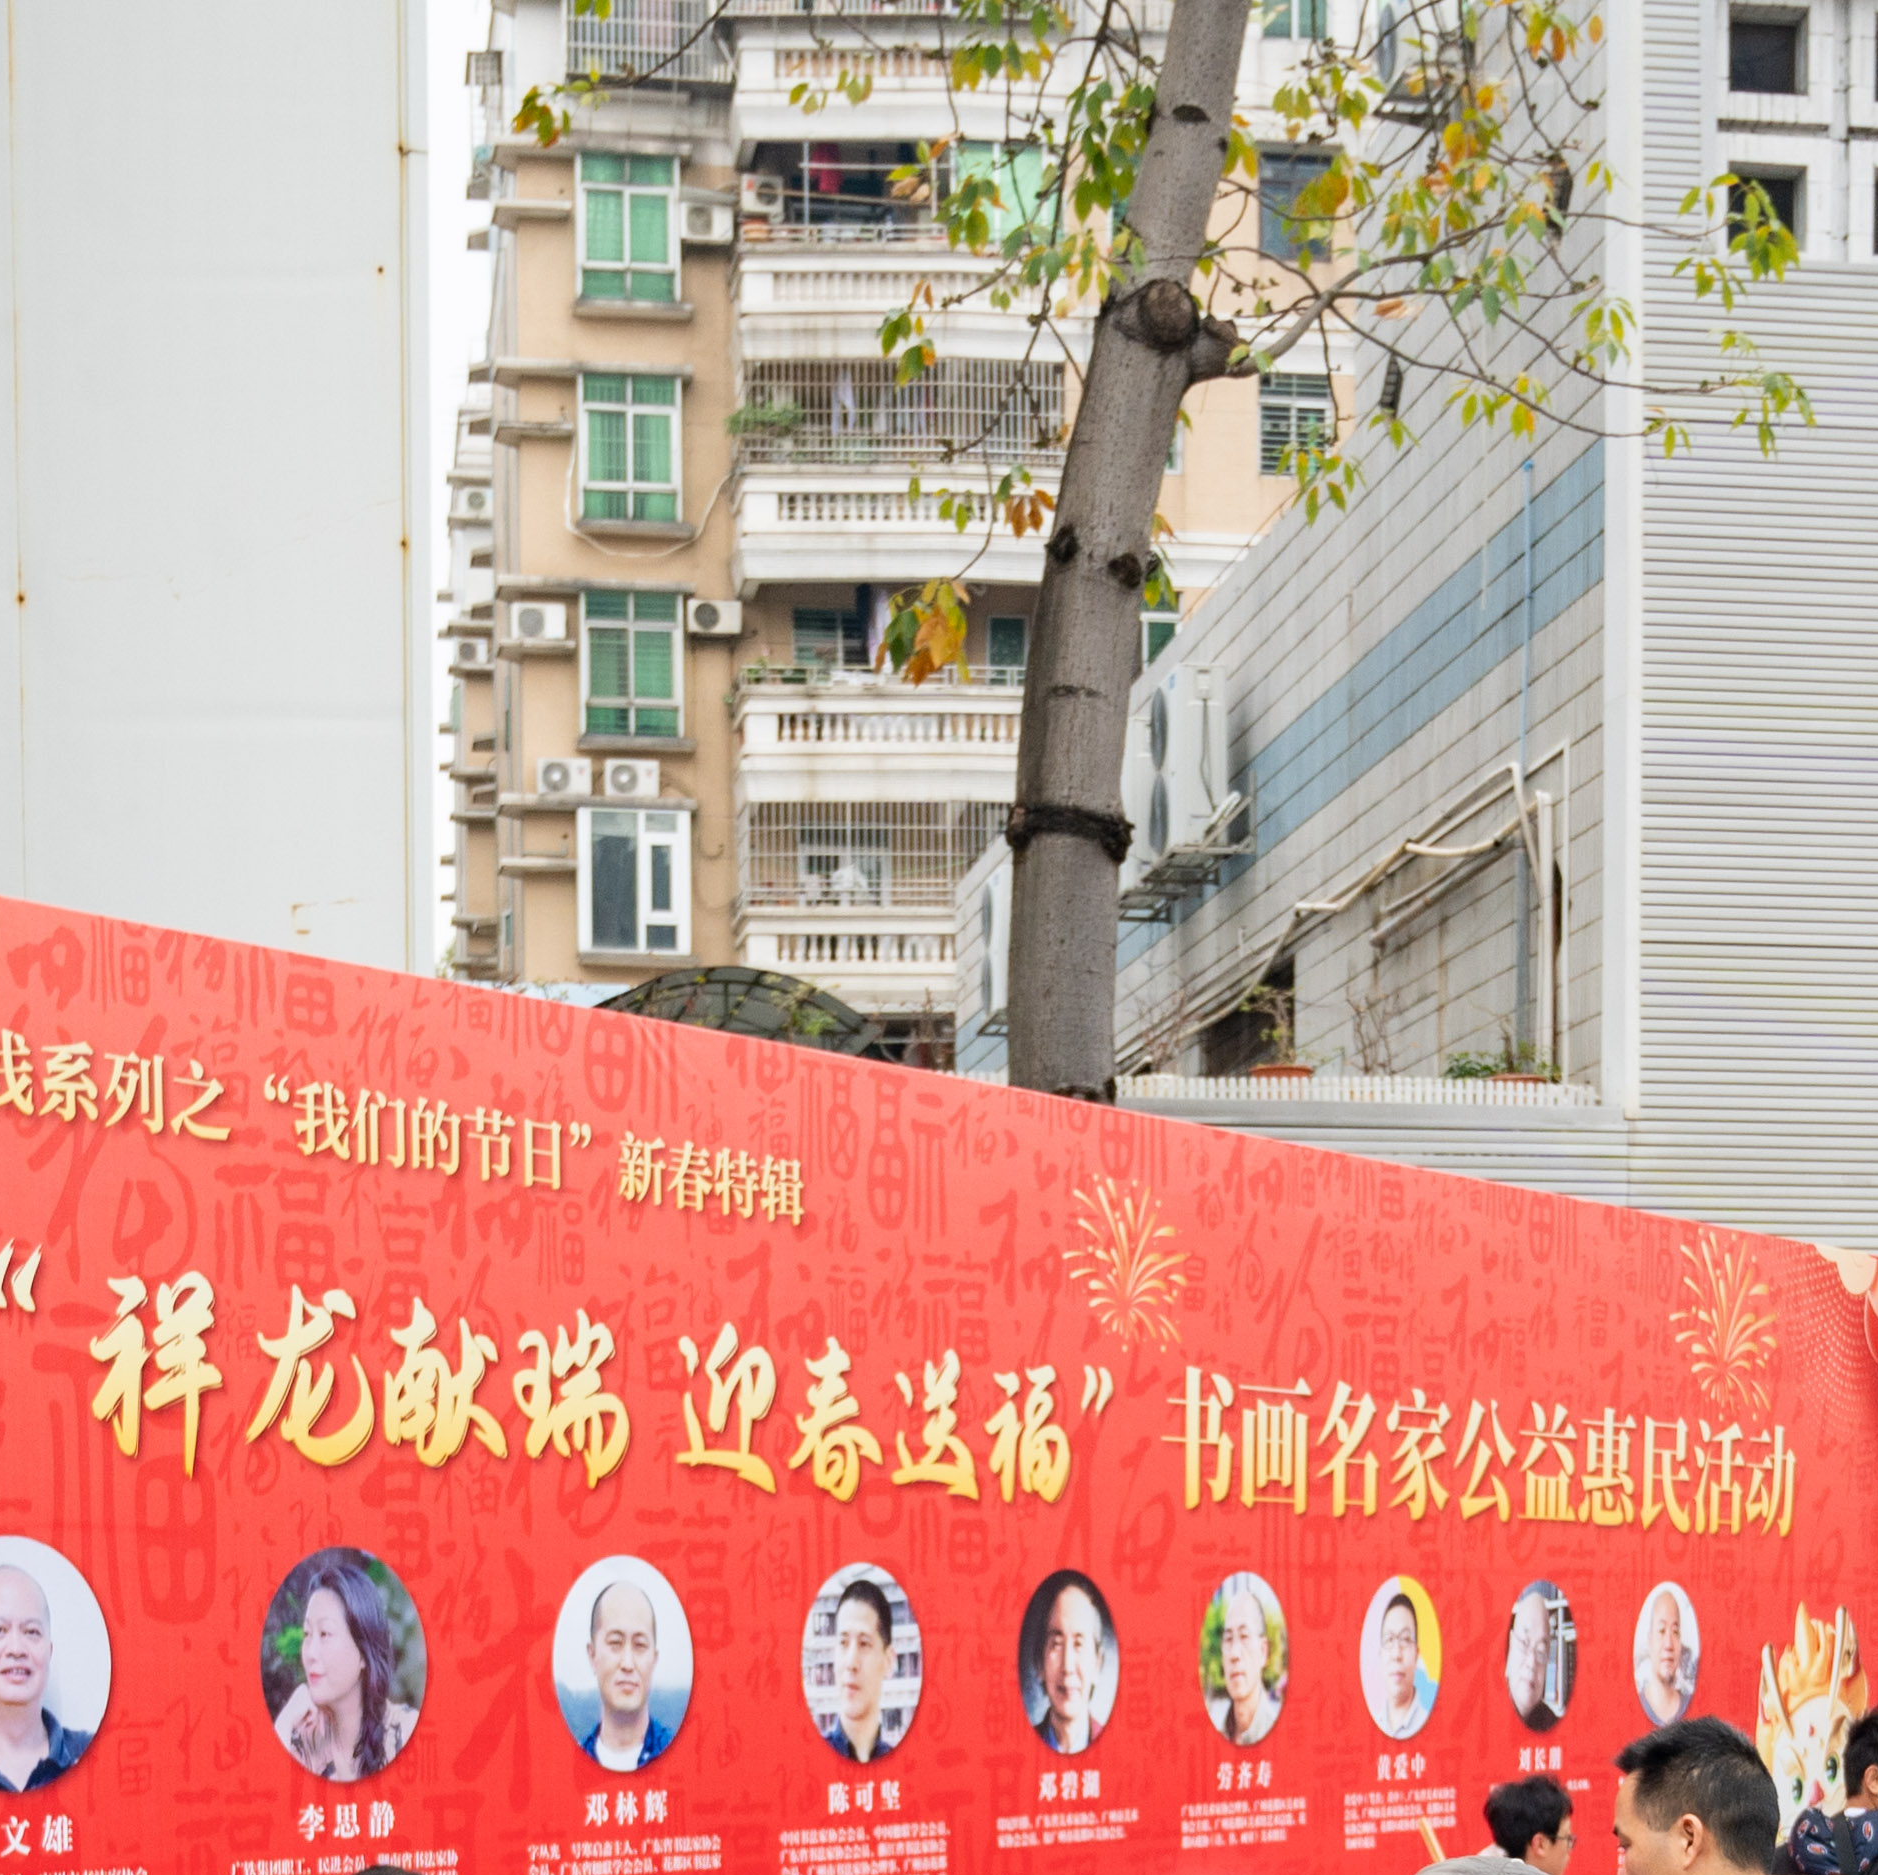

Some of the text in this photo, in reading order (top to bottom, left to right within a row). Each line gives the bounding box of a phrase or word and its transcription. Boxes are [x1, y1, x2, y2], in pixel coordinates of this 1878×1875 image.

[298, 1800, 395, 1841] 李思静
[584, 1789, 668, 1827] 邓林辉
